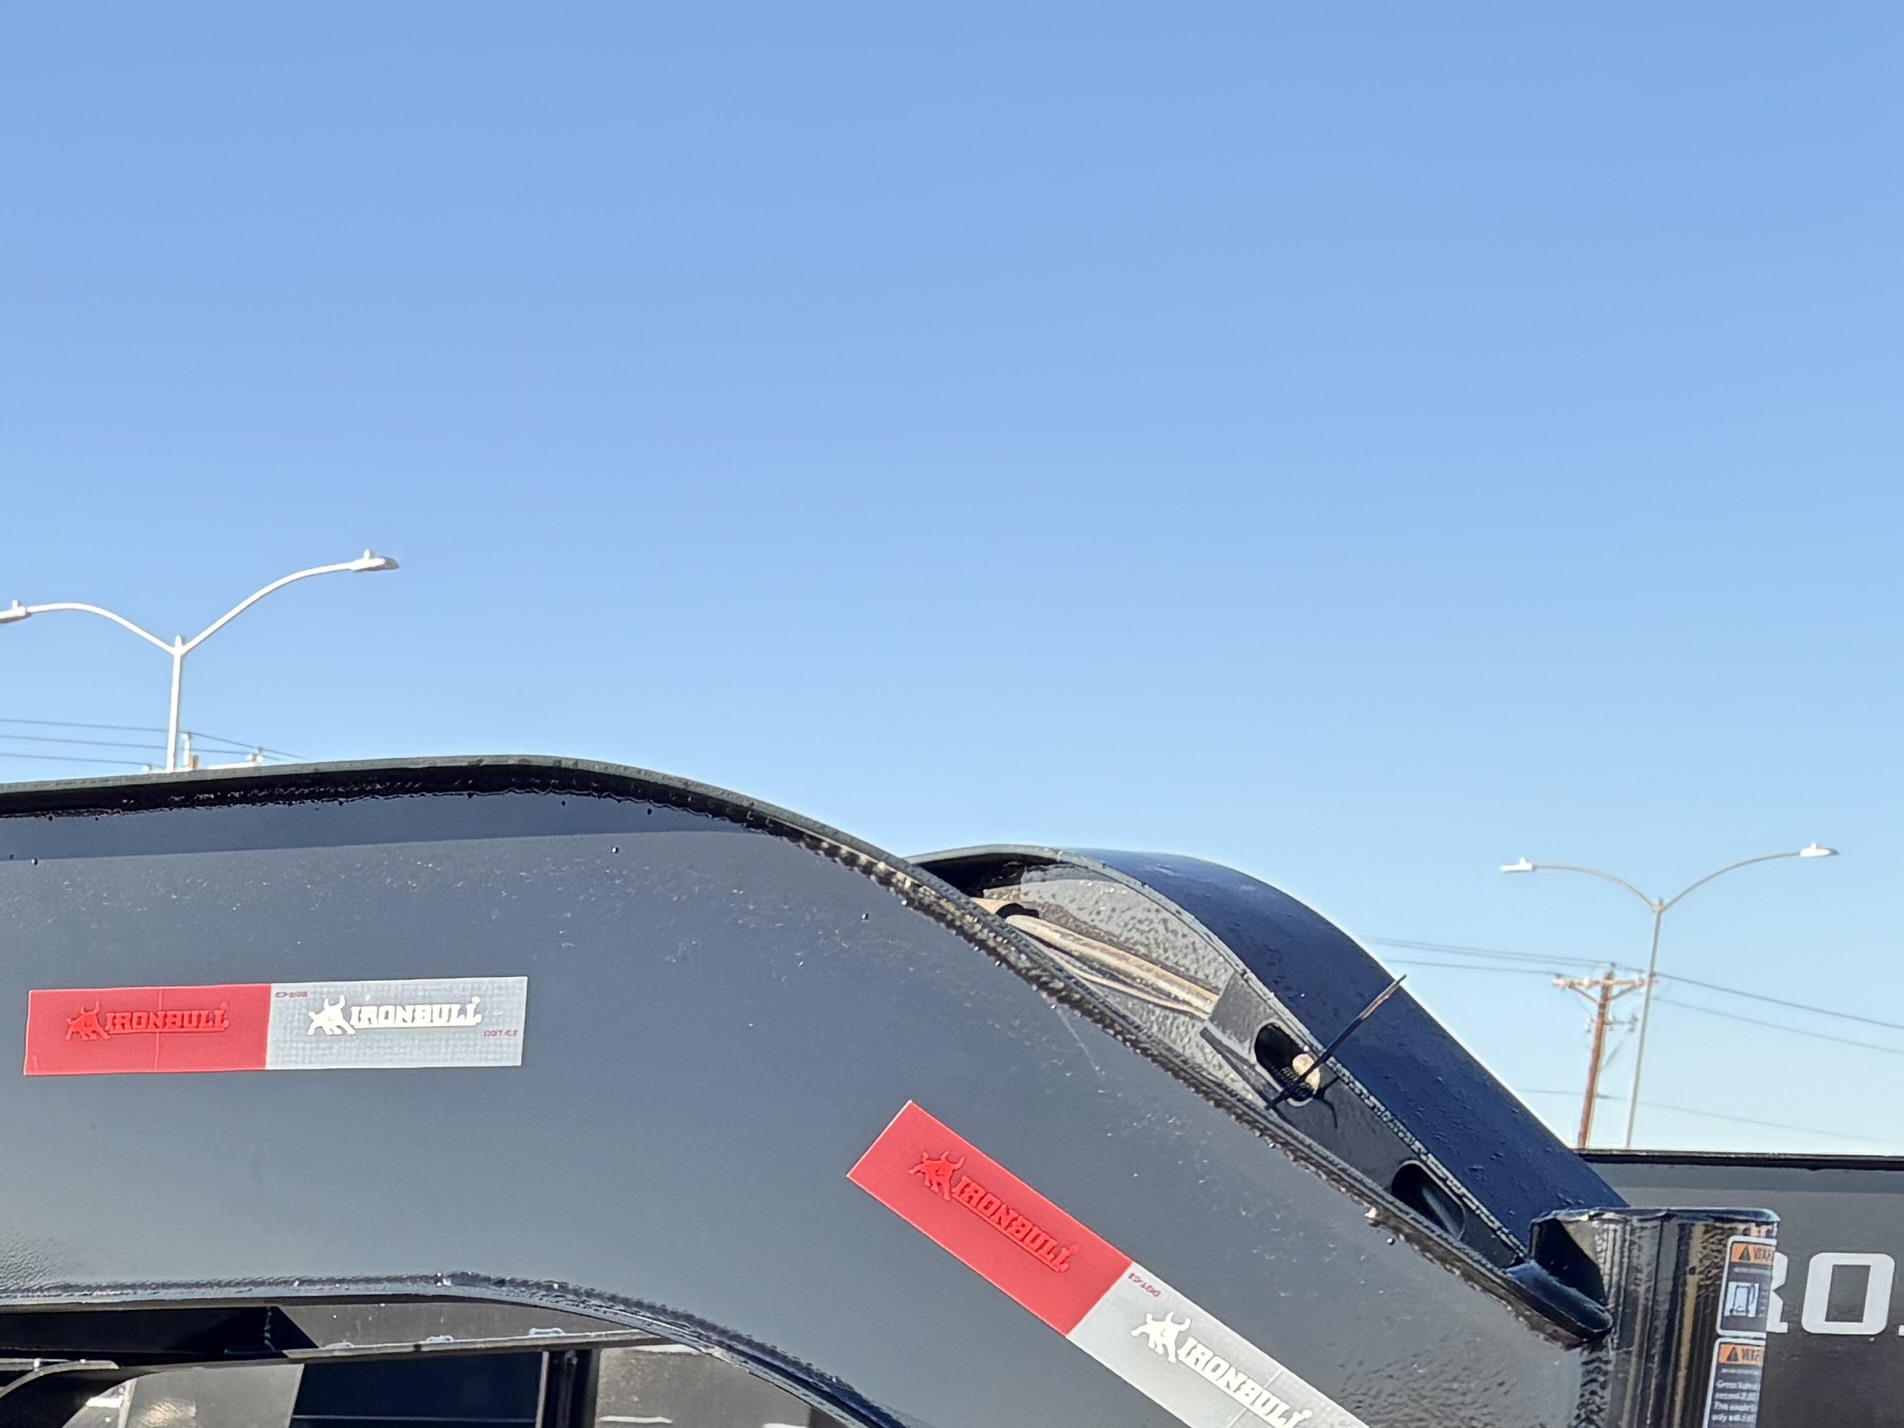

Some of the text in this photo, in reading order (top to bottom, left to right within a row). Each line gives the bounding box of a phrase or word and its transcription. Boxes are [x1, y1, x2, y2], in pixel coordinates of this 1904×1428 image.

[104, 1009, 230, 1034] IRONBULL
[349, 1002, 483, 1030] IRONBULL
[951, 1175, 1071, 1274] IRONBULL
